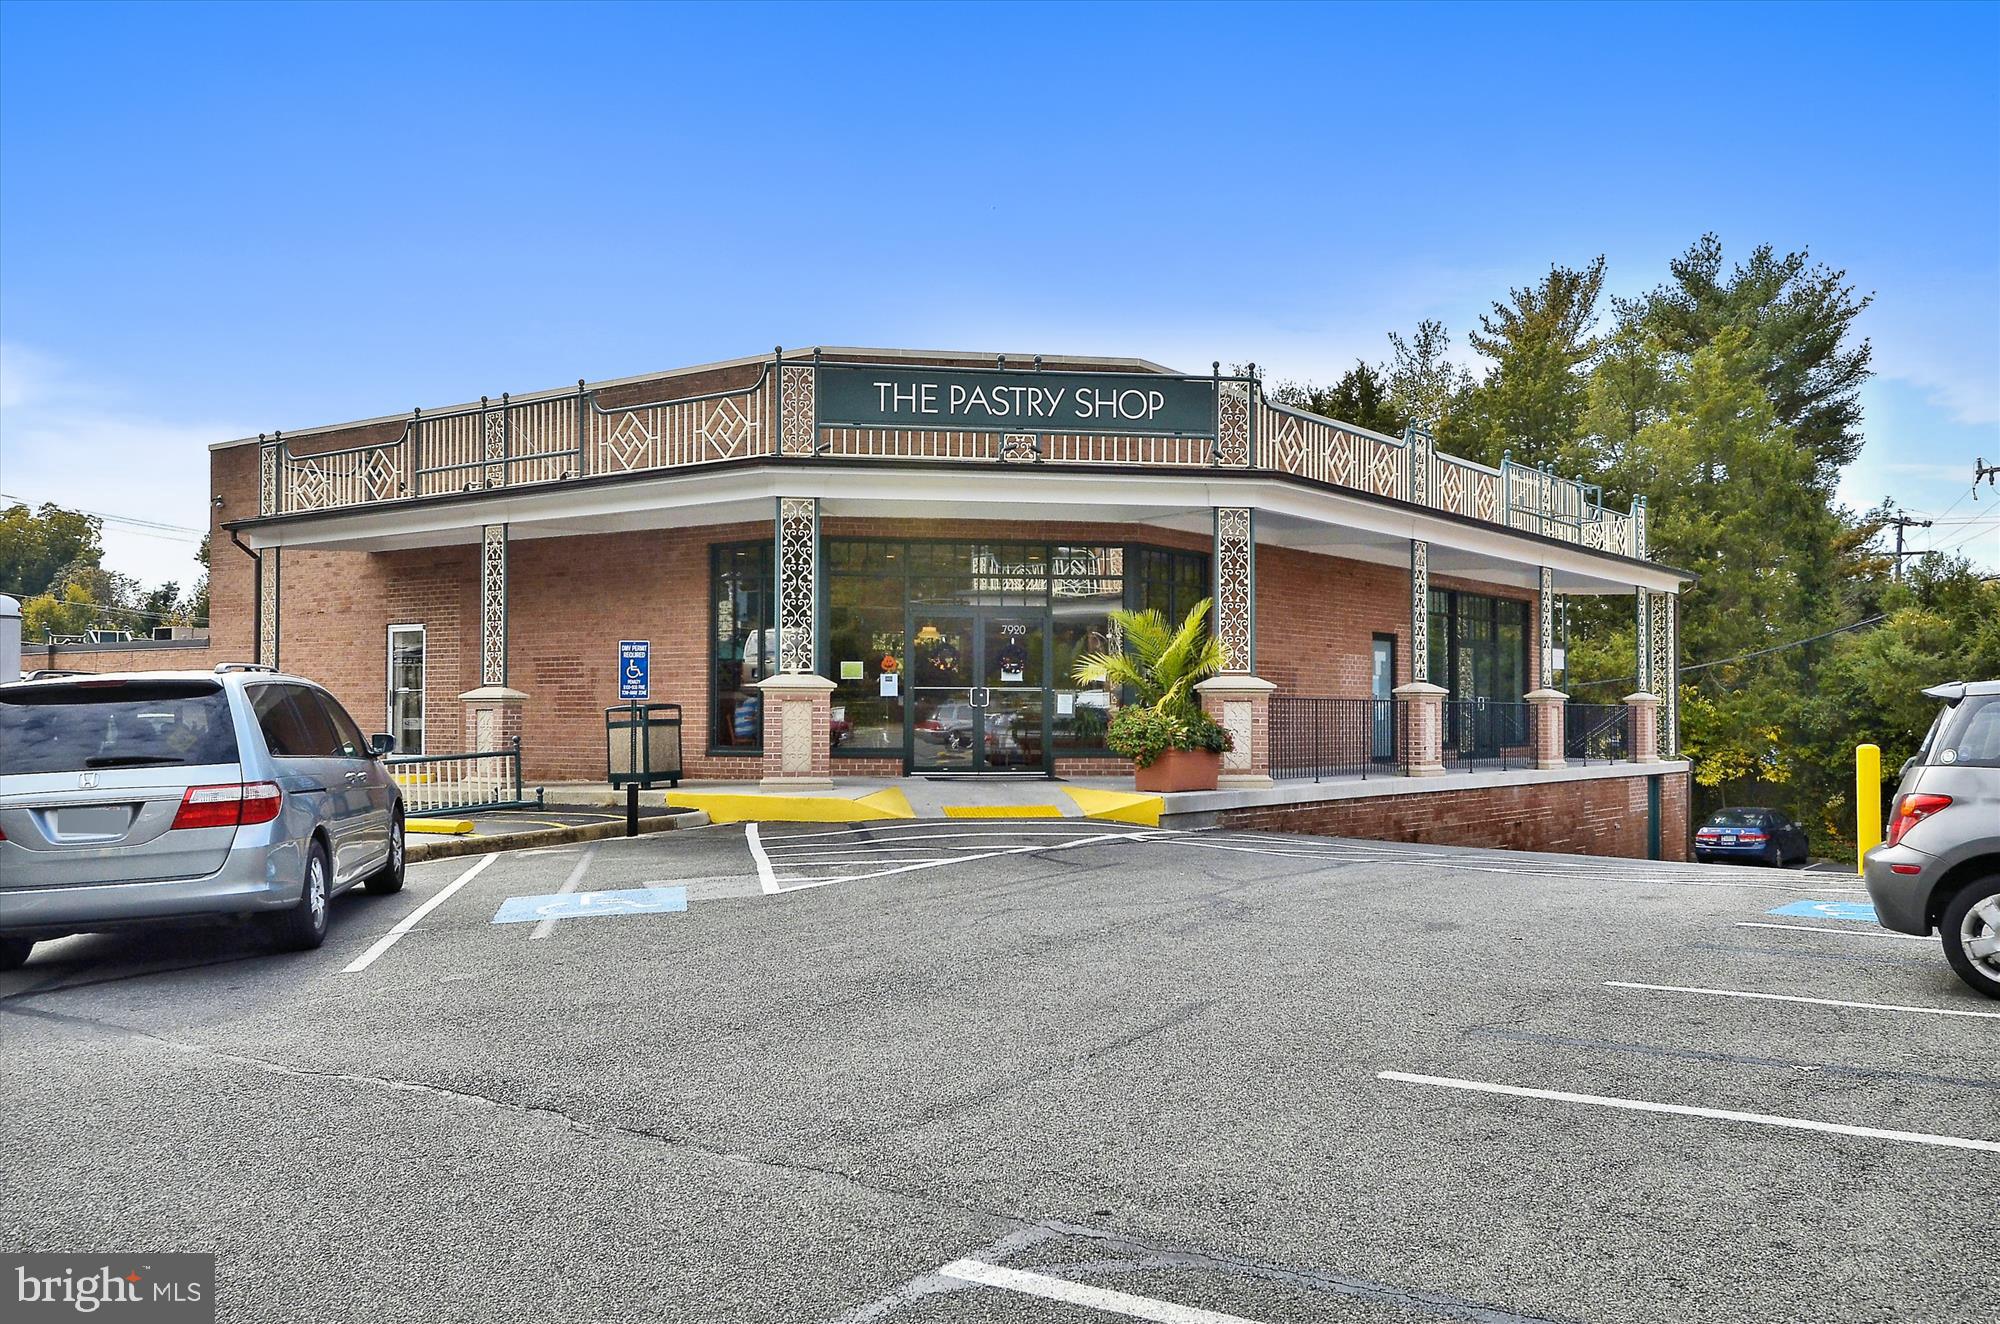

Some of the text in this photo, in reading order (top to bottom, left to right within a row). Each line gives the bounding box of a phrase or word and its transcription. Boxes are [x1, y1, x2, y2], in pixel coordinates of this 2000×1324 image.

[873, 382, 1164, 420] THE PASTRY SHOP
[1001, 624, 1027, 635] 7920
